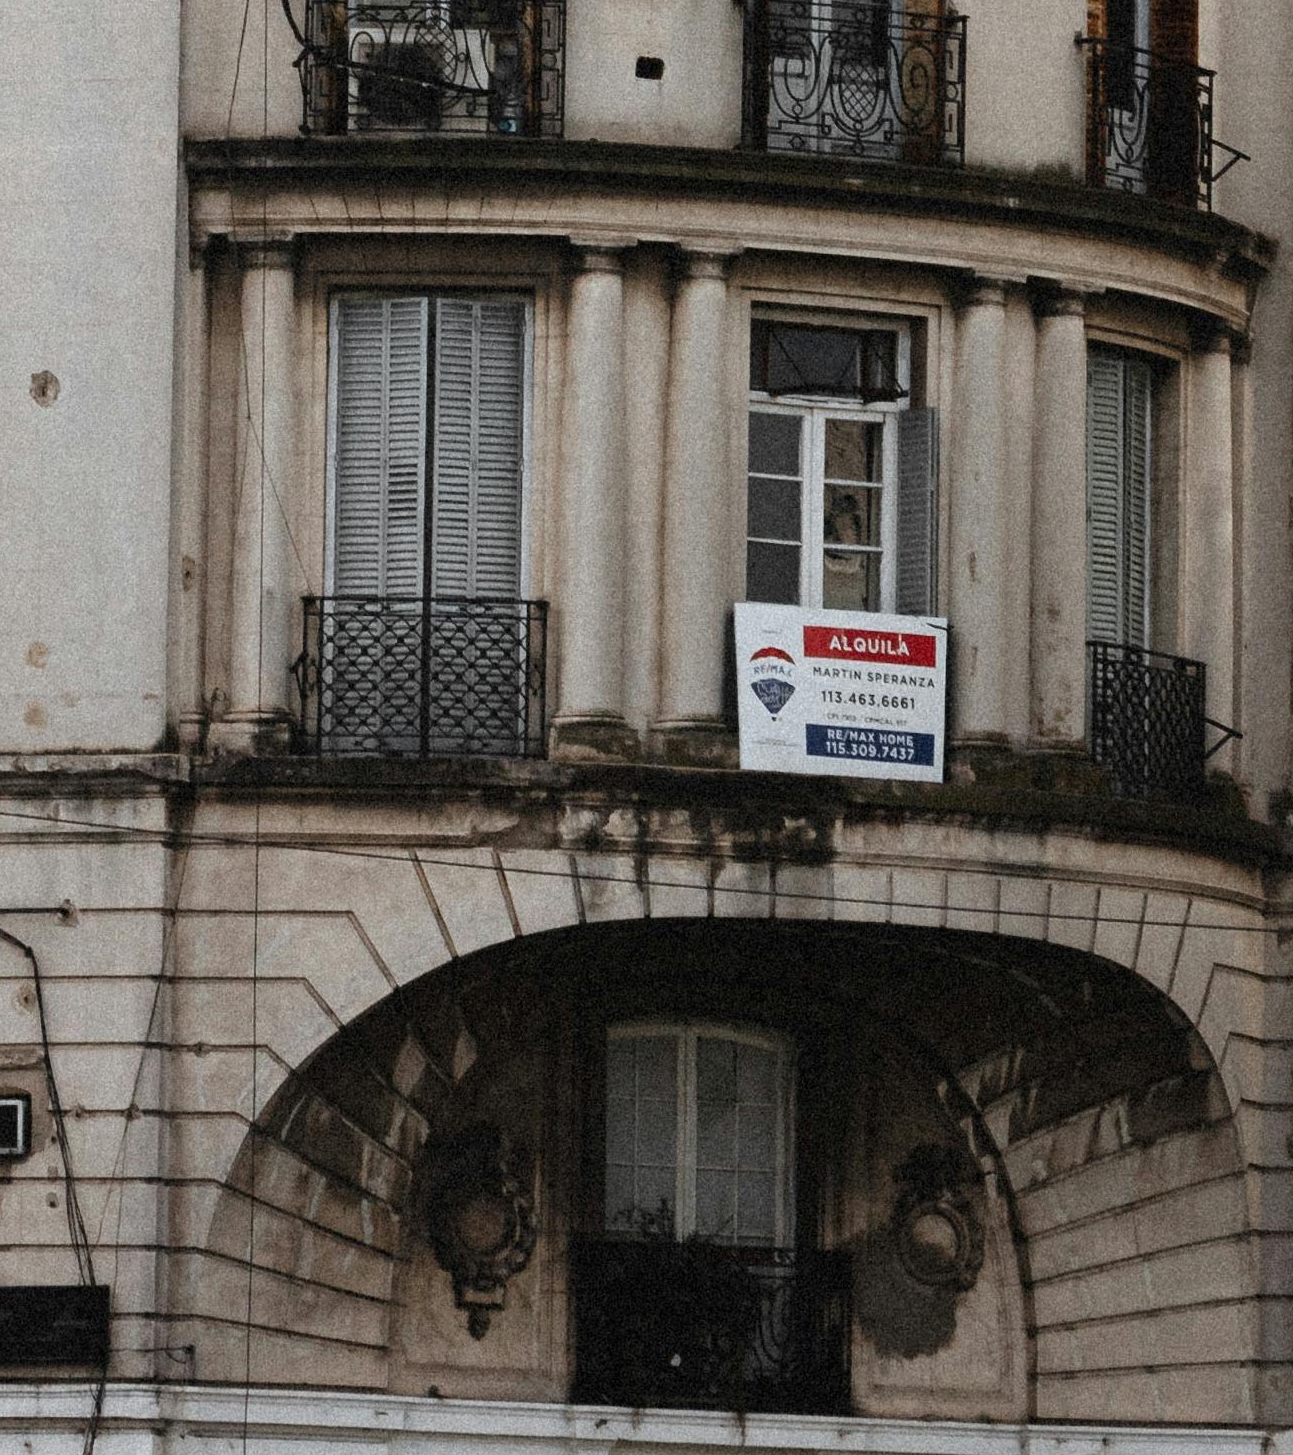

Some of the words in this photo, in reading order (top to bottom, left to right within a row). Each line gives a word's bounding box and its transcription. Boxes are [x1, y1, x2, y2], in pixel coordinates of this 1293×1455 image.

[829, 635, 910, 657] ALQUILA
[812, 666, 862, 682] MARTIN
[867, 671, 935, 689] SPERANZA
[821, 690, 916, 710] 113.463.6661
[827, 729, 875, 743] RE/MAX
[879, 733, 914, 747] HOME
[826, 741, 915, 761] 115.309.7437
